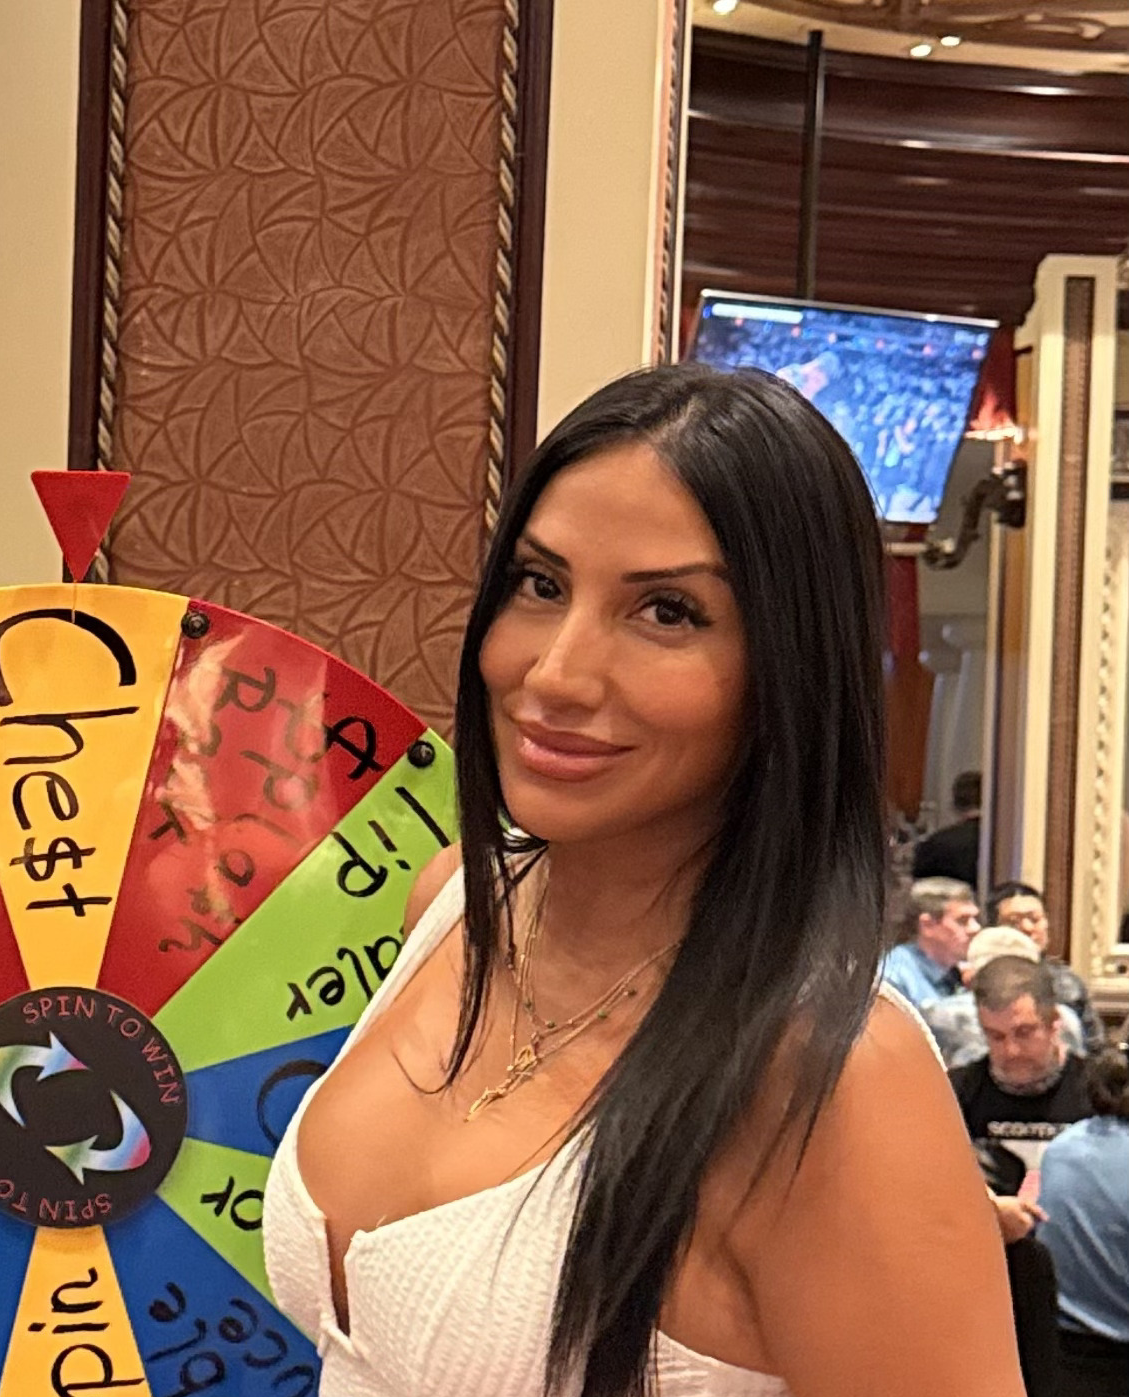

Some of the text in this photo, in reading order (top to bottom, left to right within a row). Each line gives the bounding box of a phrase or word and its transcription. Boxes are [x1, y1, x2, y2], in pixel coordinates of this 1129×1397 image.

[285, 926, 405, 1021] aler
[22, 994, 183, 1105] SPIN TO WIN
[37, 1192, 113, 1222] SPIN
